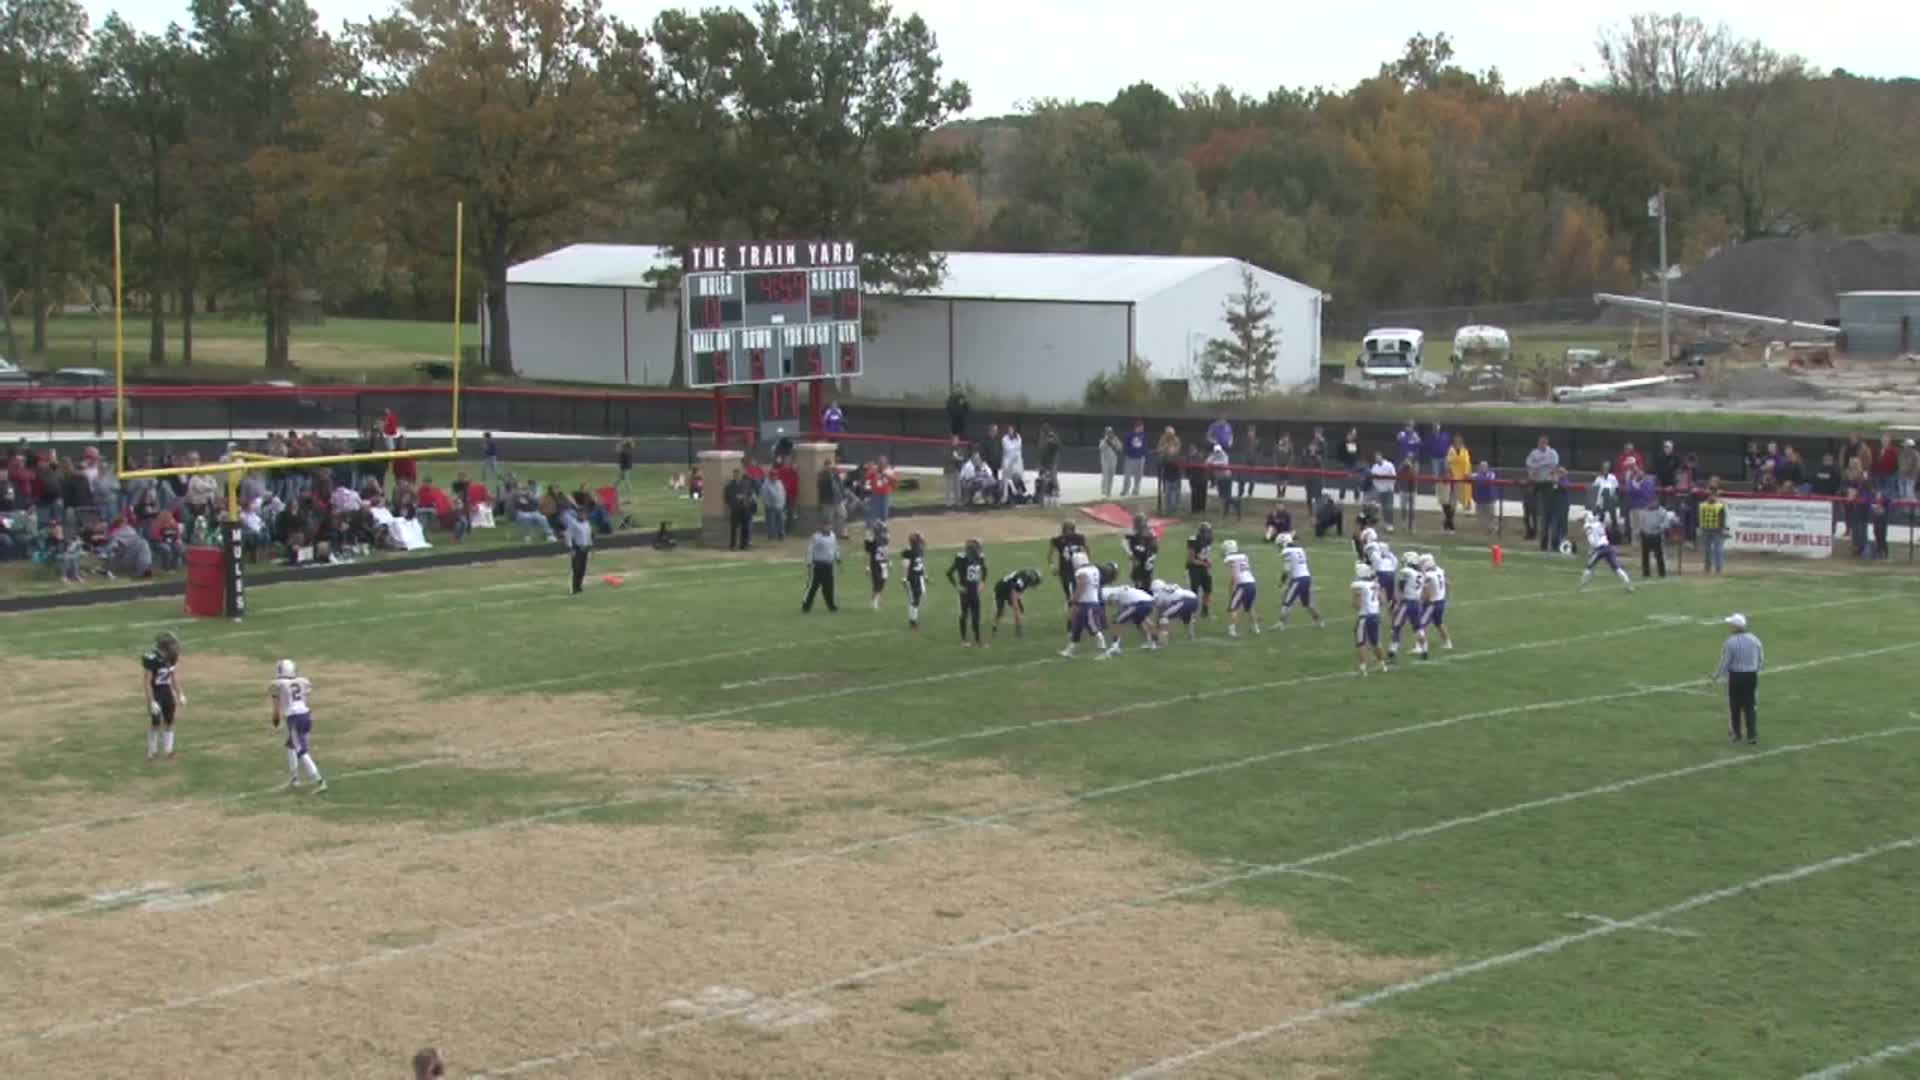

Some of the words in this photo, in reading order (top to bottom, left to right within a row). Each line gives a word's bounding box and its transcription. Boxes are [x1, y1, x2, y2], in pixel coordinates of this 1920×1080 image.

[692, 247, 726, 269] THE
[739, 244, 796, 267] TRAIN
[808, 242, 854, 265] YARD
[699, 275, 733, 296] MULES
[692, 333, 715, 353] BALL
[742, 330, 772, 349] DOWN
[232, 529, 244, 608] MULES
[289, 683, 302, 701] 2
